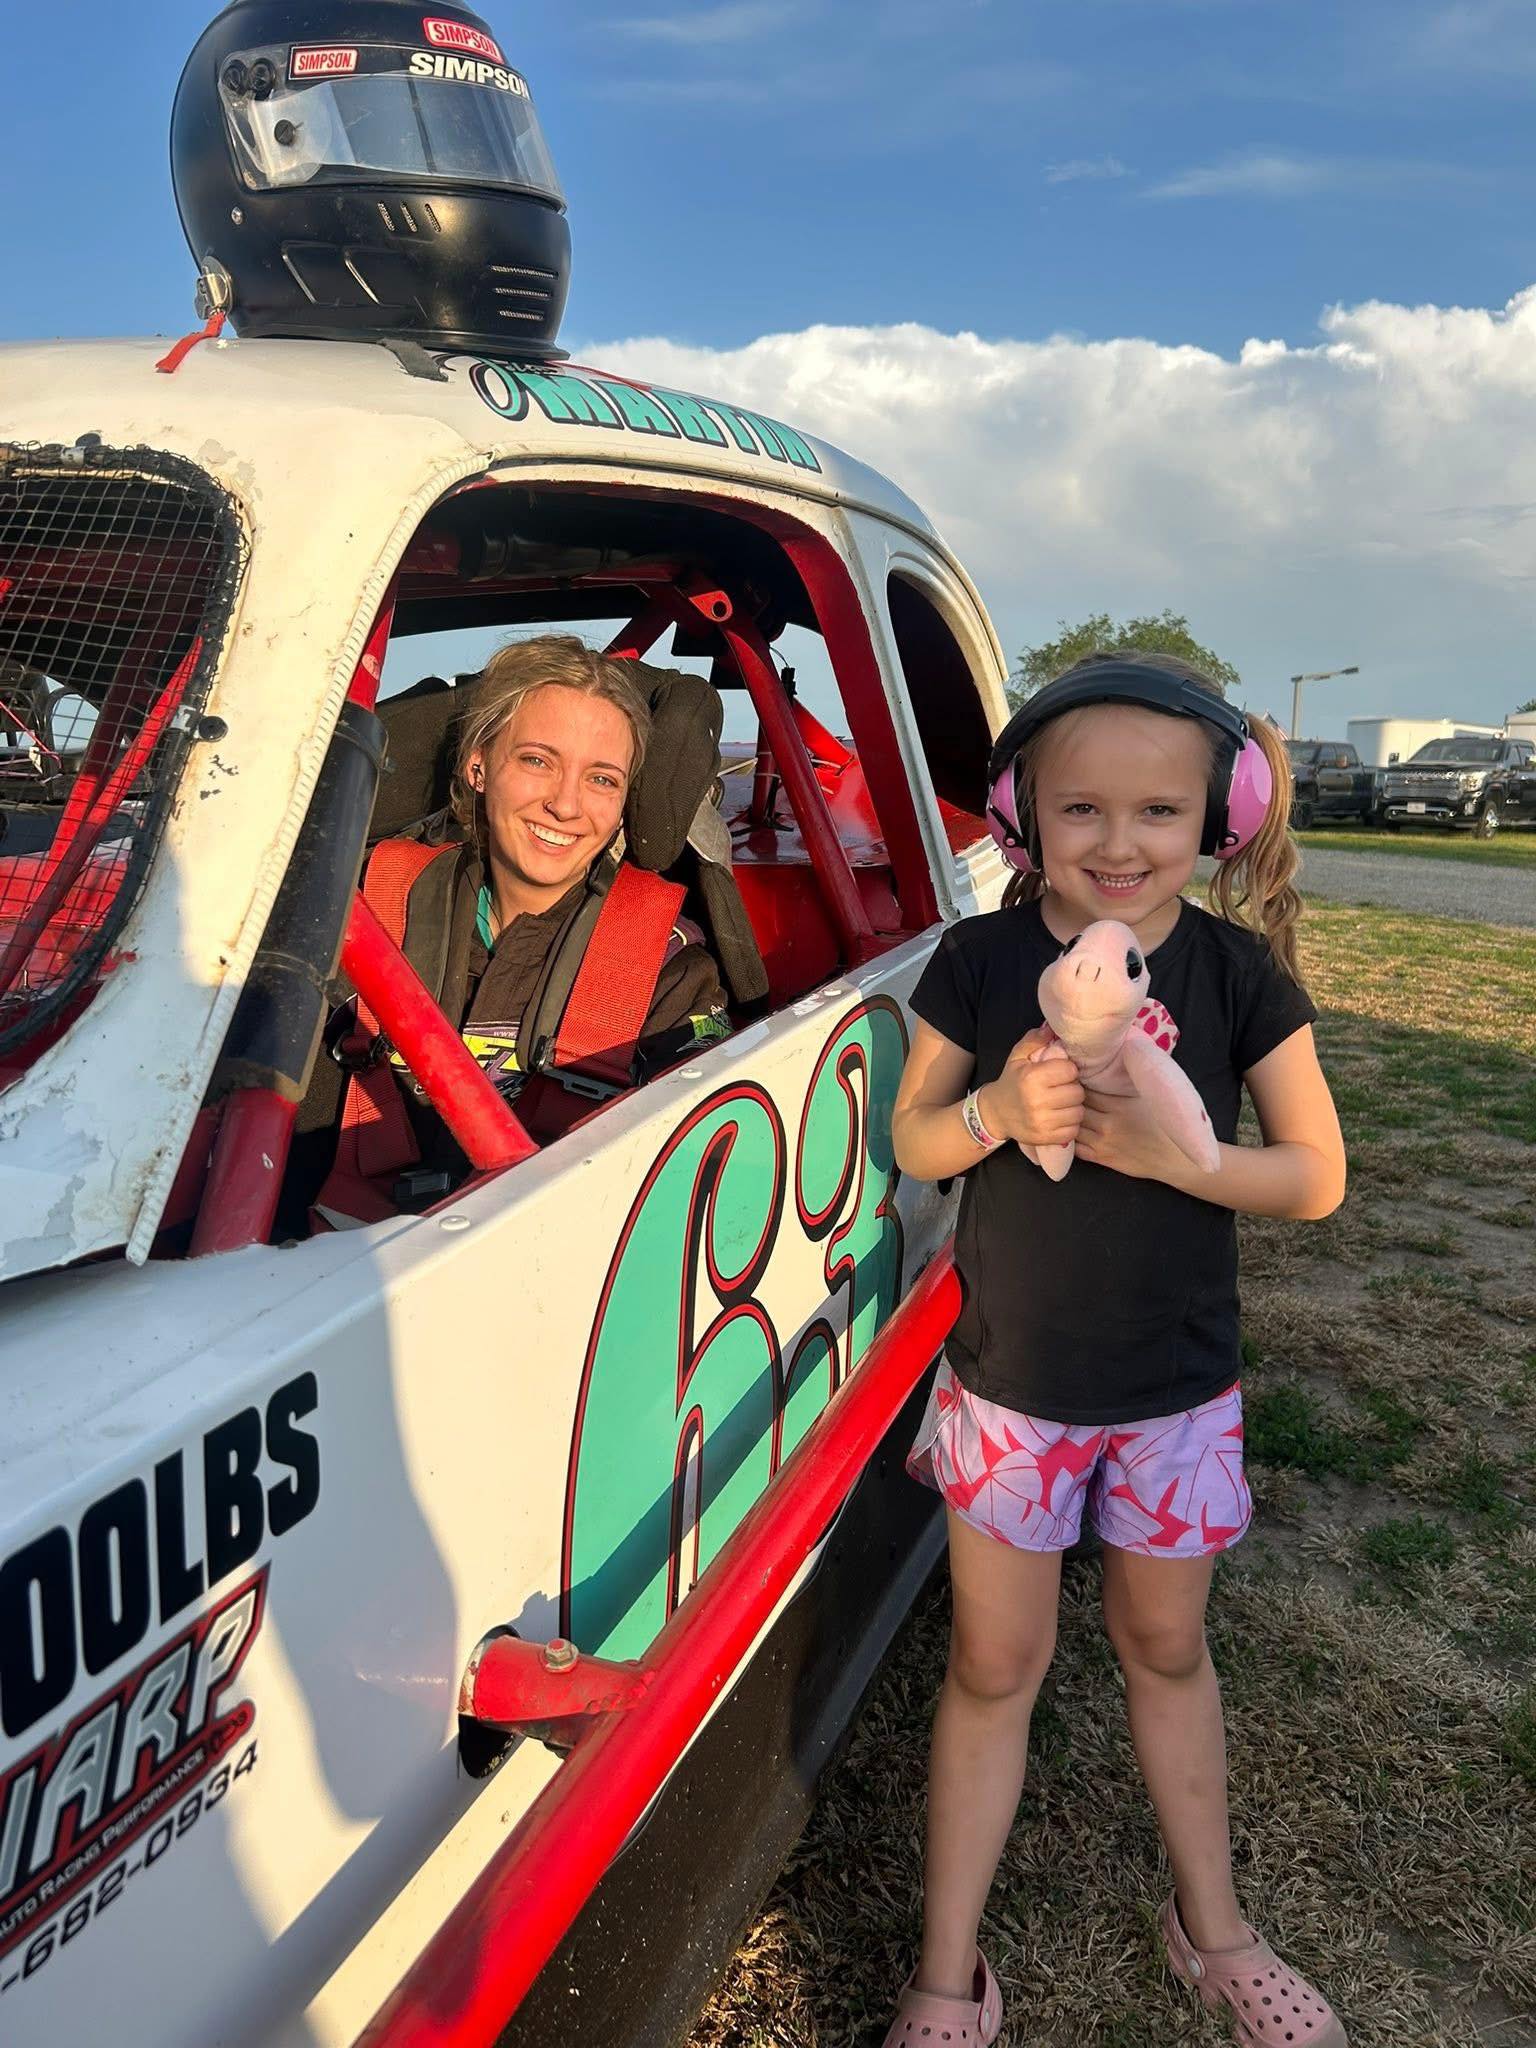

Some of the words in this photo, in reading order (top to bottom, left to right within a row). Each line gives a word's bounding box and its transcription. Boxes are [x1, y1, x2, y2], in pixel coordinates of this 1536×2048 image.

[432, 23, 499, 57] SIMPSON
[409, 52, 530, 100] SIMPSON
[39, 1843, 103, 1903] RACING
[101, 1748, 206, 1845] PERFORMANCE
